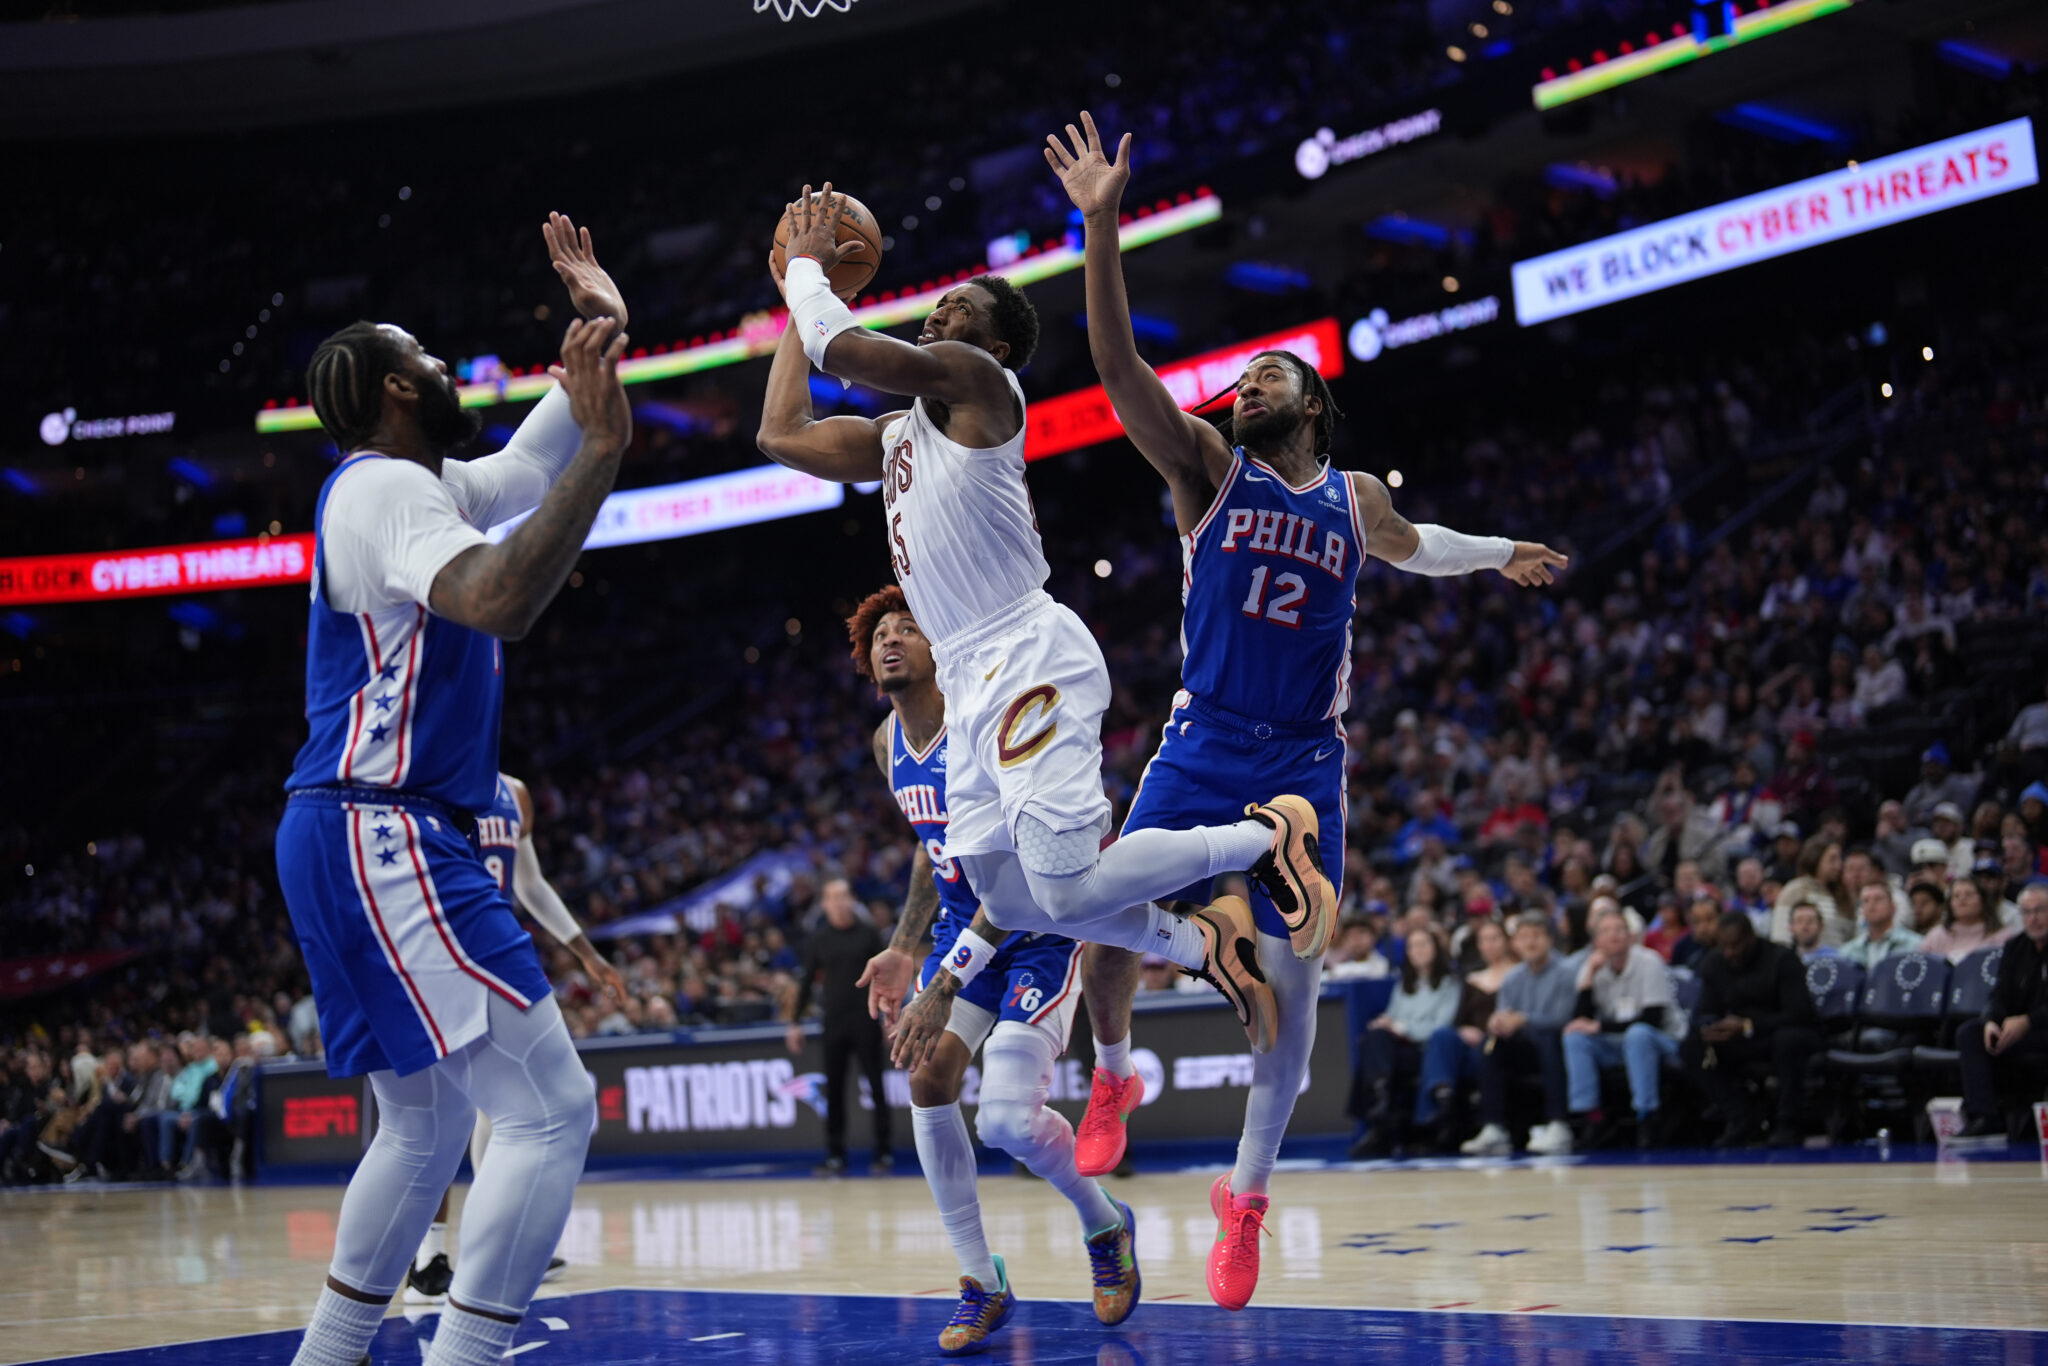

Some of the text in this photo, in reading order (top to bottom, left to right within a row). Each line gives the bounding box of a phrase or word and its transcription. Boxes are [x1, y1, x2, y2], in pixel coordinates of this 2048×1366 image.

[1543, 141, 2011, 299] WE BLOCK CYBER THREATS
[125, 411, 176, 435] POINT
[91, 554, 180, 592] CYBER
[182, 541, 305, 584] THREATS
[1221, 508, 1349, 582] PHILA
[1242, 565, 1310, 630] 12
[997, 684, 1061, 768] C
[894, 784, 950, 825] PHIL
[926, 838, 960, 883] 9
[953, 945, 972, 968] 9
[1008, 985, 1043, 1012] 76
[284, 1095, 357, 1138] ESPN
[624, 1058, 798, 1133] PATRIOTS
